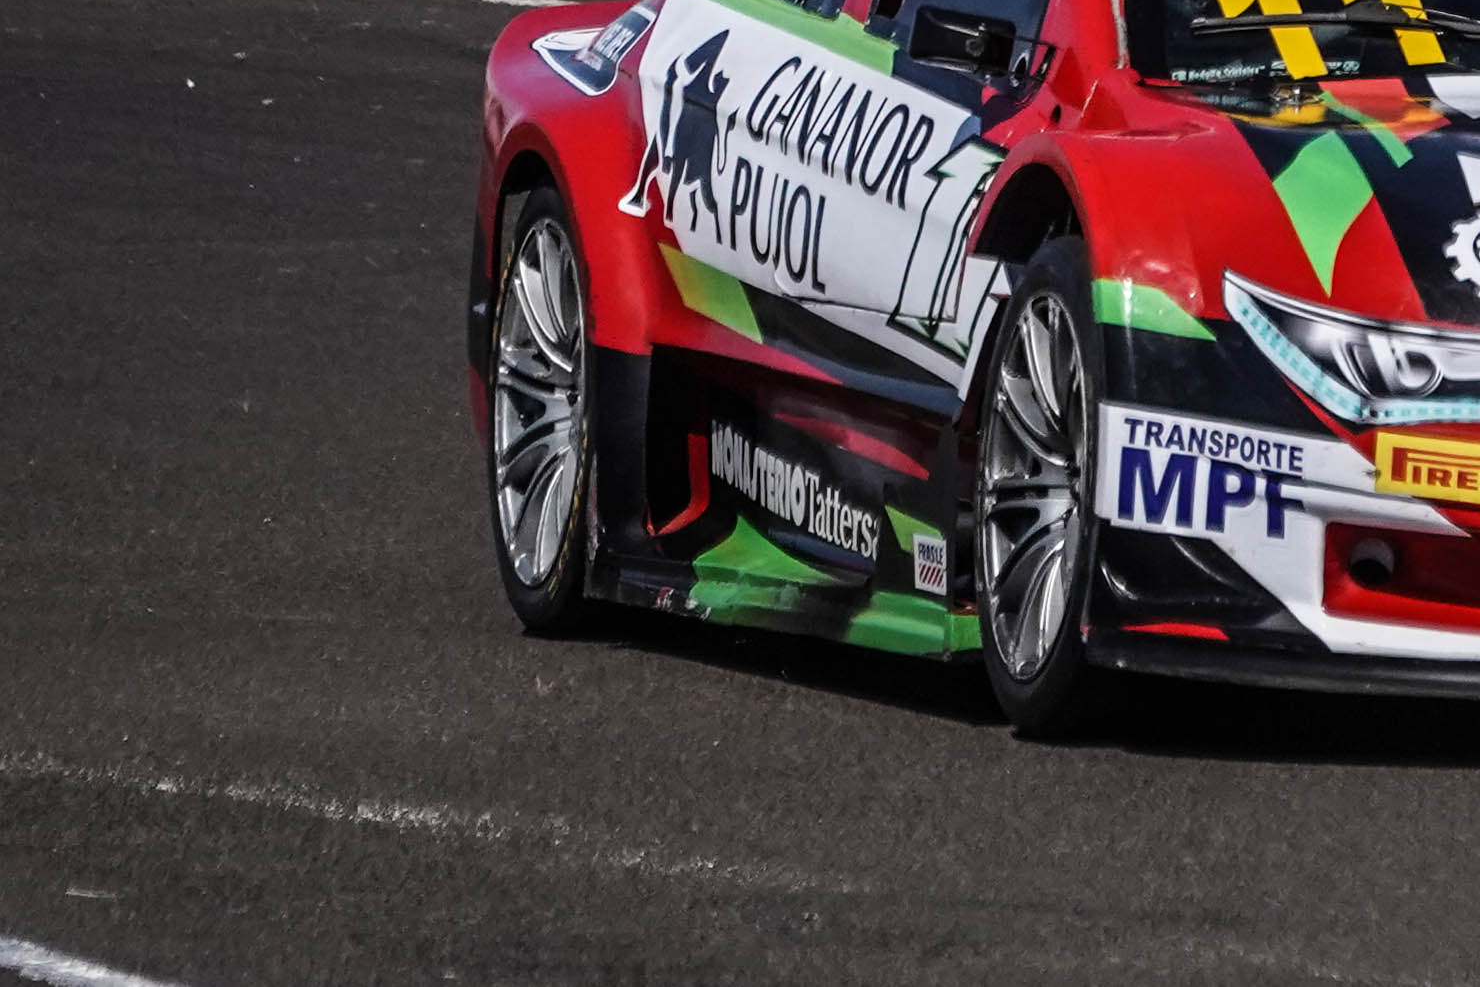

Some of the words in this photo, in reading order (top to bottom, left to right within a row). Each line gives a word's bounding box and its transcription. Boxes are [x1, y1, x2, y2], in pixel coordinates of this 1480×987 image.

[745, 55, 935, 211] GANANOR
[729, 156, 827, 295] PUJOL
[1116, 446, 1306, 540] MPF
[1123, 417, 1305, 474] TRANSPORTE
